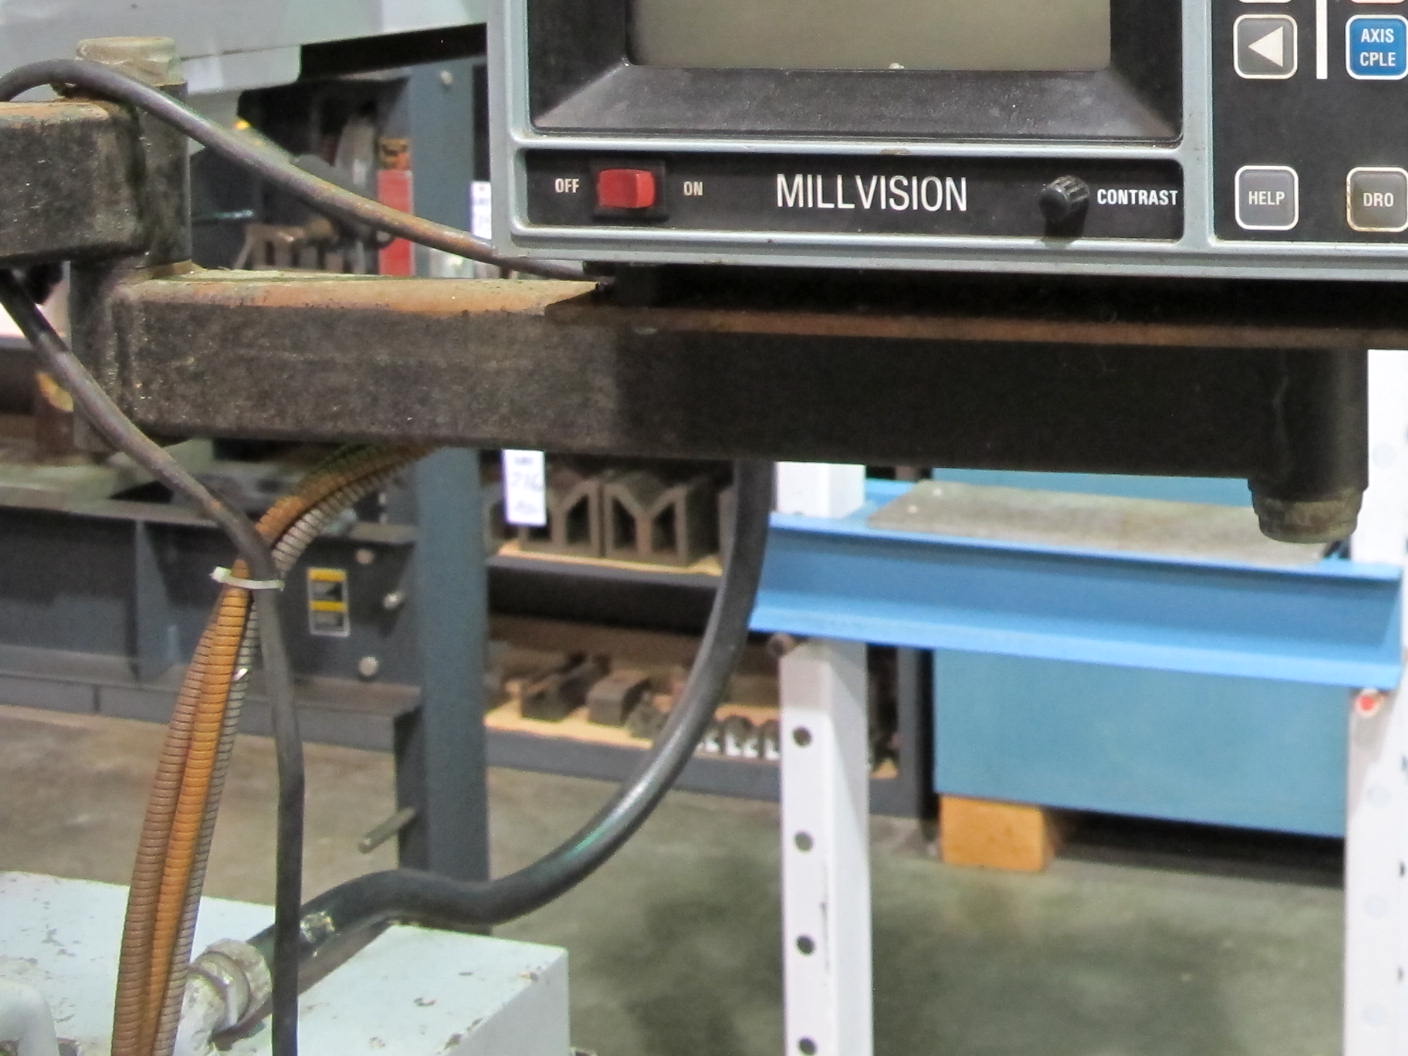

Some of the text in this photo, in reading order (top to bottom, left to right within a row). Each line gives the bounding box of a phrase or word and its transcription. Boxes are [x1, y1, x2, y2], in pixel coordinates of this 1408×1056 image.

[1361, 29, 1394, 43] AXIS
[1360, 52, 1395, 66] CPLE
[555, 178, 579, 192] OFF
[684, 181, 702, 195] ON
[777, 174, 966, 211] MILLVISION
[1097, 189, 1177, 205] CONTRAST
[1249, 191, 1285, 205] HELP
[1364, 193, 1393, 207] DRO
